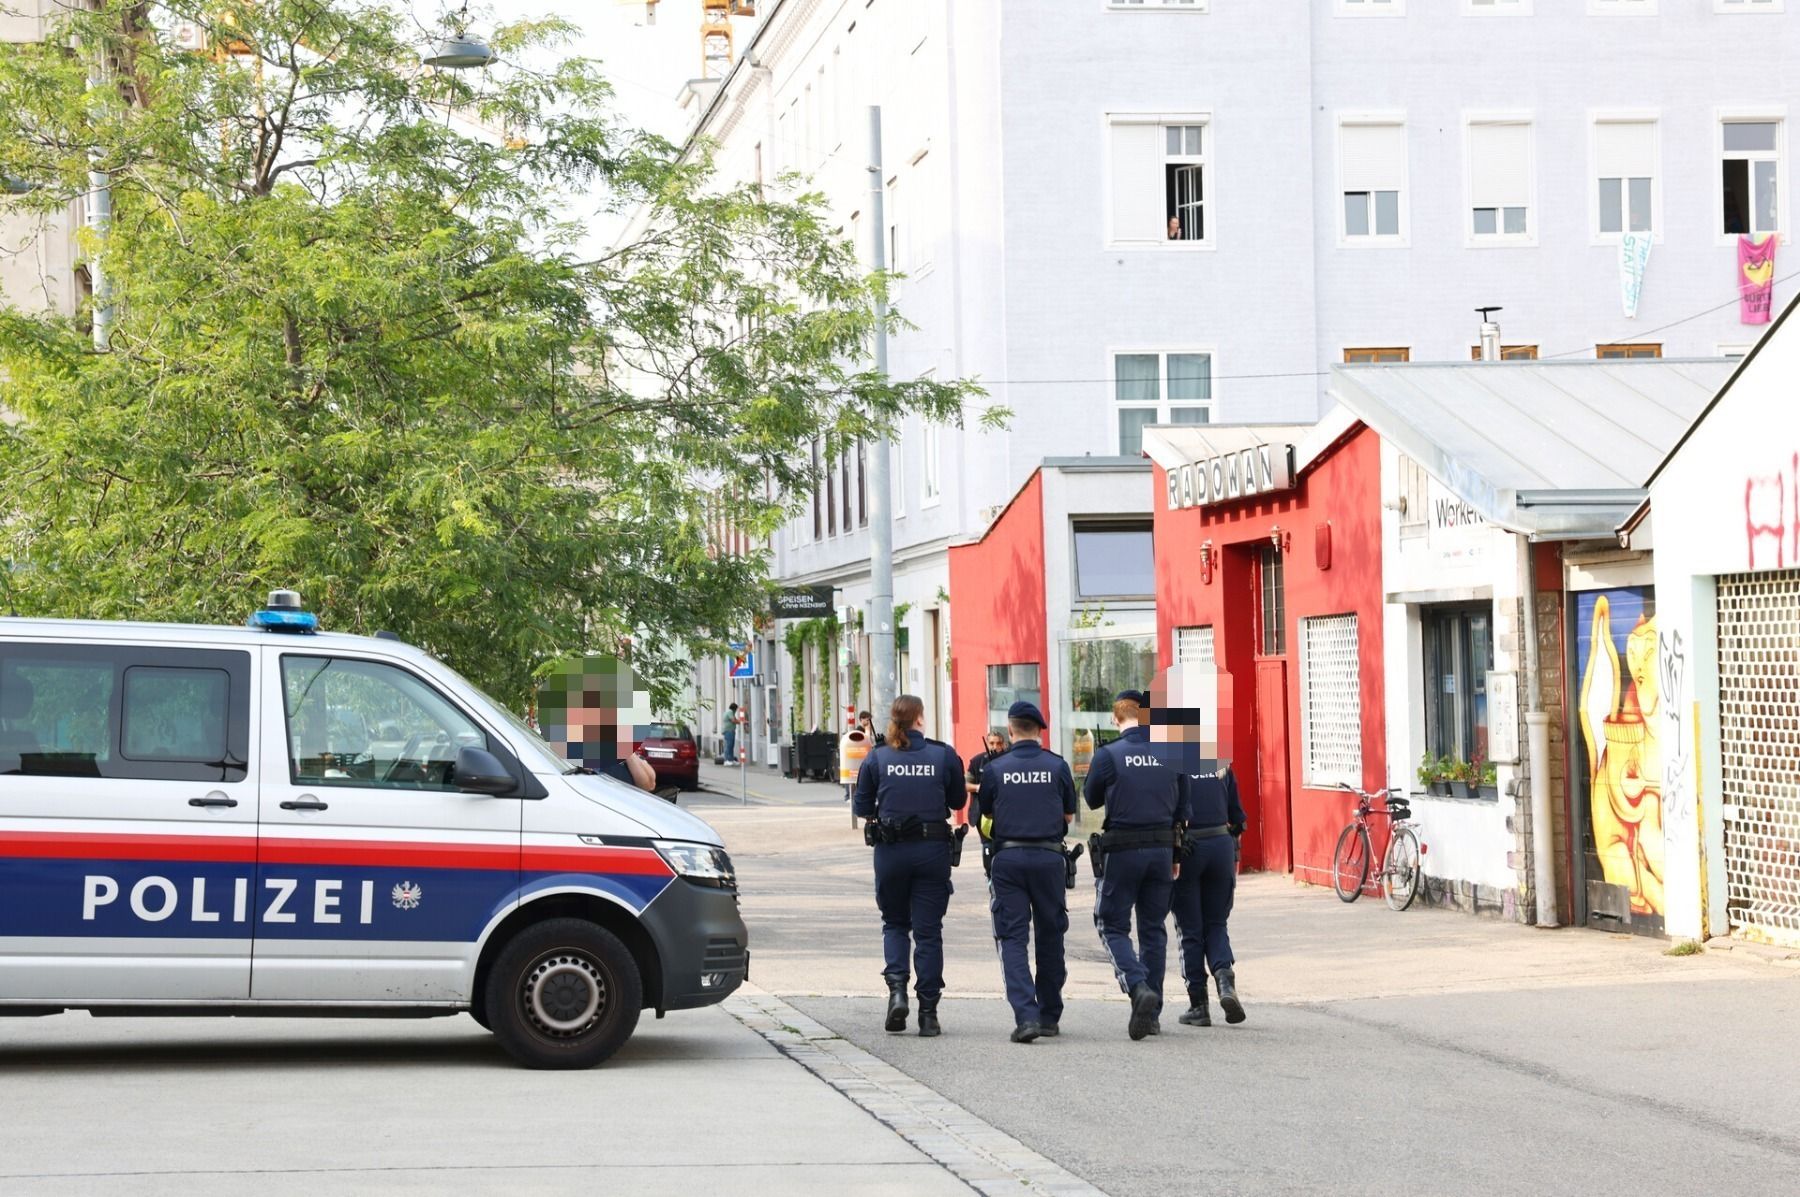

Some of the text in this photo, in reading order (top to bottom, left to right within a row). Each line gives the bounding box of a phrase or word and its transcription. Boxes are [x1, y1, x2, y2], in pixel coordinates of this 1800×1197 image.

[1169, 448, 1273, 505] RADOWAN
[887, 764, 935, 777] POLIZEI
[1003, 771, 1051, 784] POLIZEI
[82, 875, 374, 924] POLIZEI
